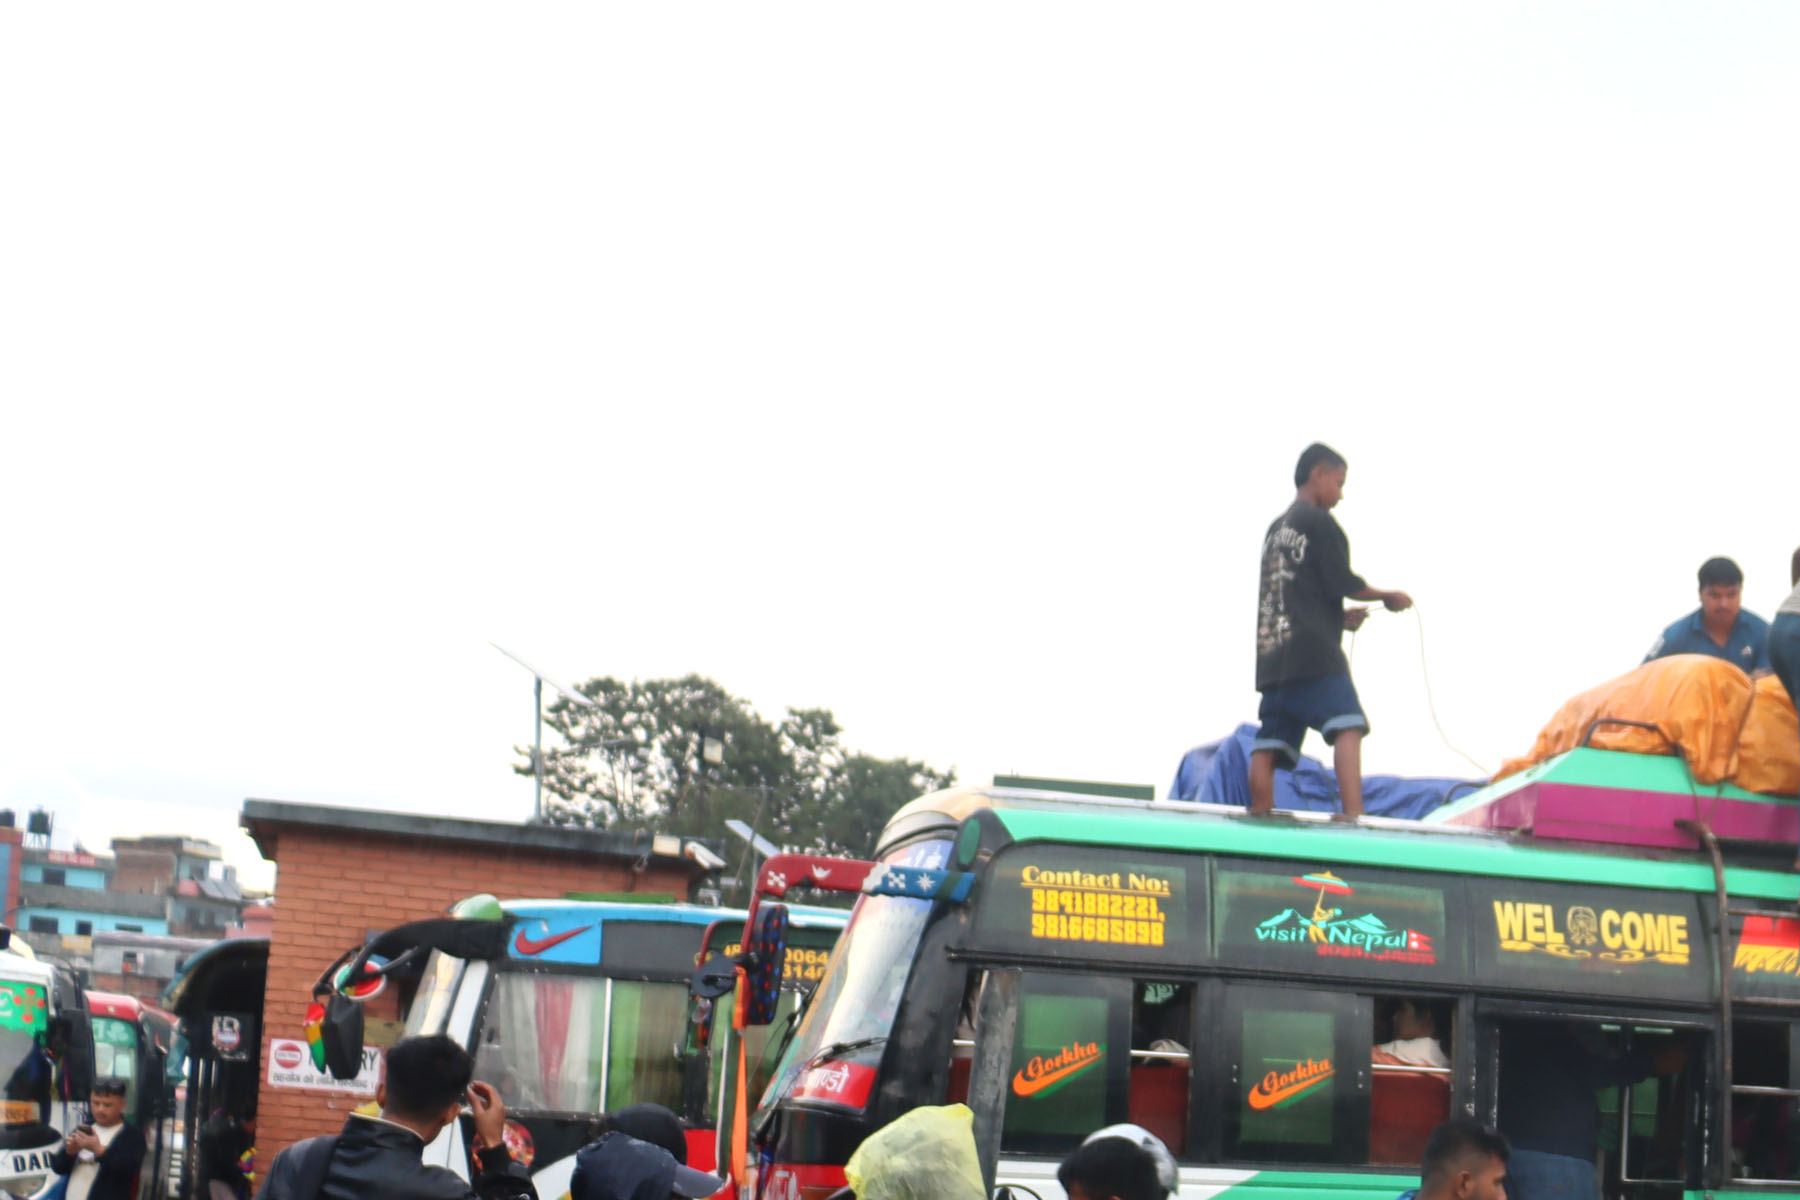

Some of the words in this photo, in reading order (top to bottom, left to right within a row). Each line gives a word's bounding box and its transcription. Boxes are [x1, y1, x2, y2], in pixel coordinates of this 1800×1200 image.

[1021, 865, 1120, 888] Contact
[1128, 872, 1169, 892] No:
[1026, 1041, 1099, 1079] Gorkha
[1262, 1057, 1331, 1094] Gorkha
